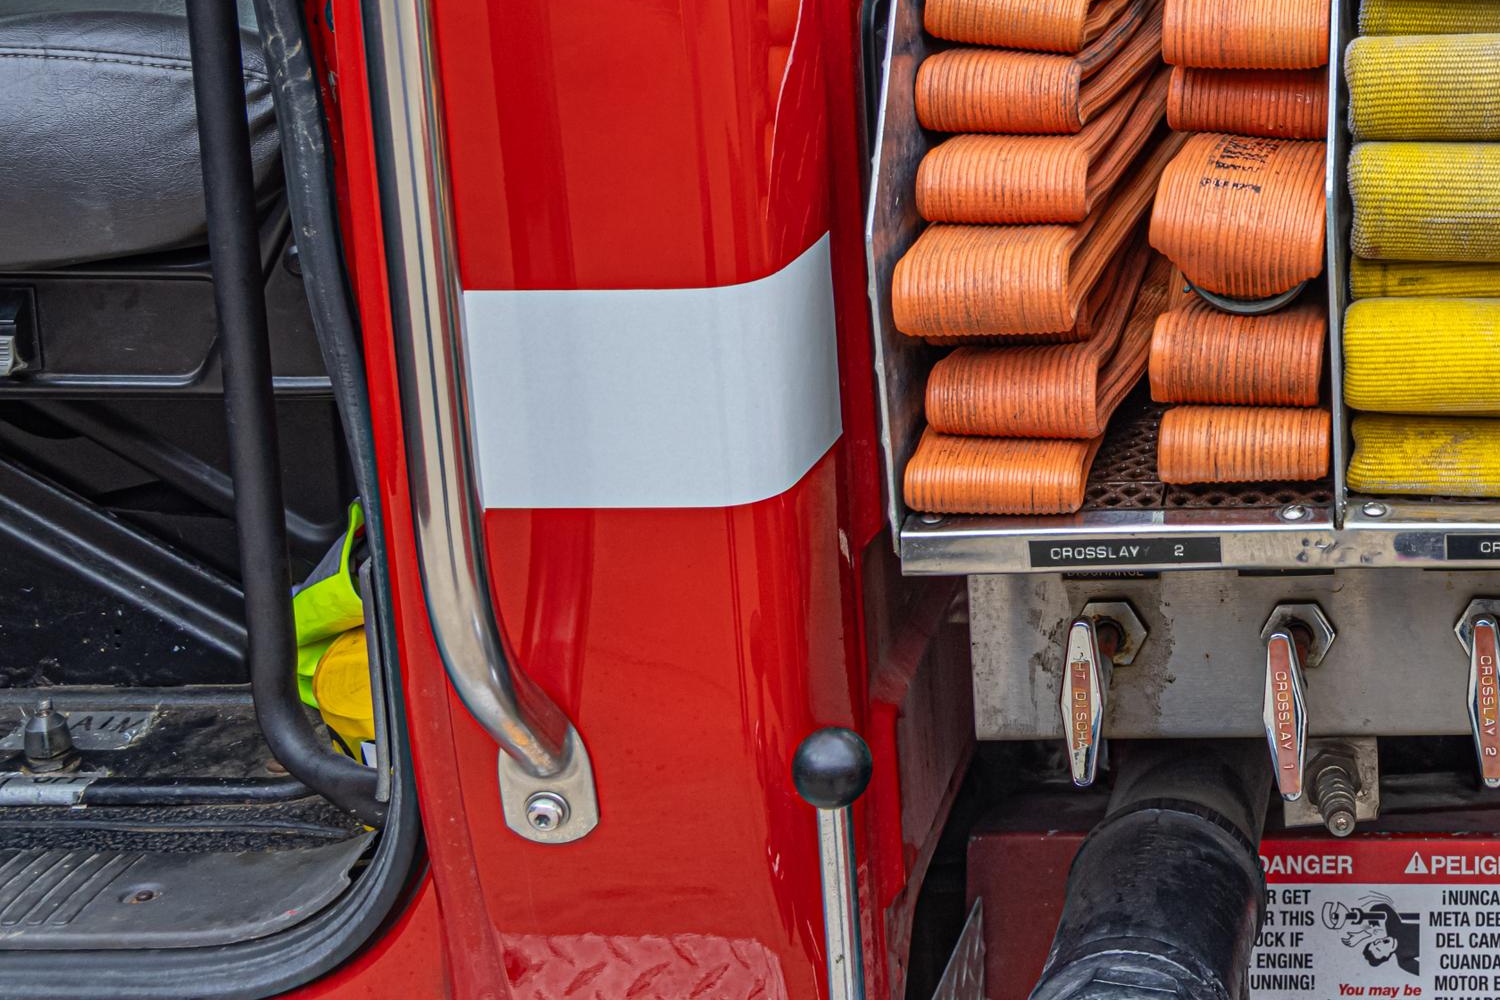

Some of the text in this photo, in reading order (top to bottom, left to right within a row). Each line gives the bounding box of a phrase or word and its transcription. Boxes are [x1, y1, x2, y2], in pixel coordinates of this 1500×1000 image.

[1050, 545, 1184, 560] CROSSLAY 2
[1275, 671, 1293, 751] CROSSLAY
[1480, 655, 1497, 756] CROSSLAY 2
[1282, 889, 1311, 905] GET
[1442, 890, 1500, 906] ¡NUNCA
[1280, 911, 1315, 926] THIS
[1429, 911, 1471, 927] META
[1254, 932, 1304, 947] UCK IF
[1435, 933, 1464, 948] DEL
[1257, 953, 1313, 969] ENGINE
[1250, 974, 1315, 990] UNNING!
[1434, 975, 1490, 991] MOTOR
[1339, 984, 1422, 999] You may be
